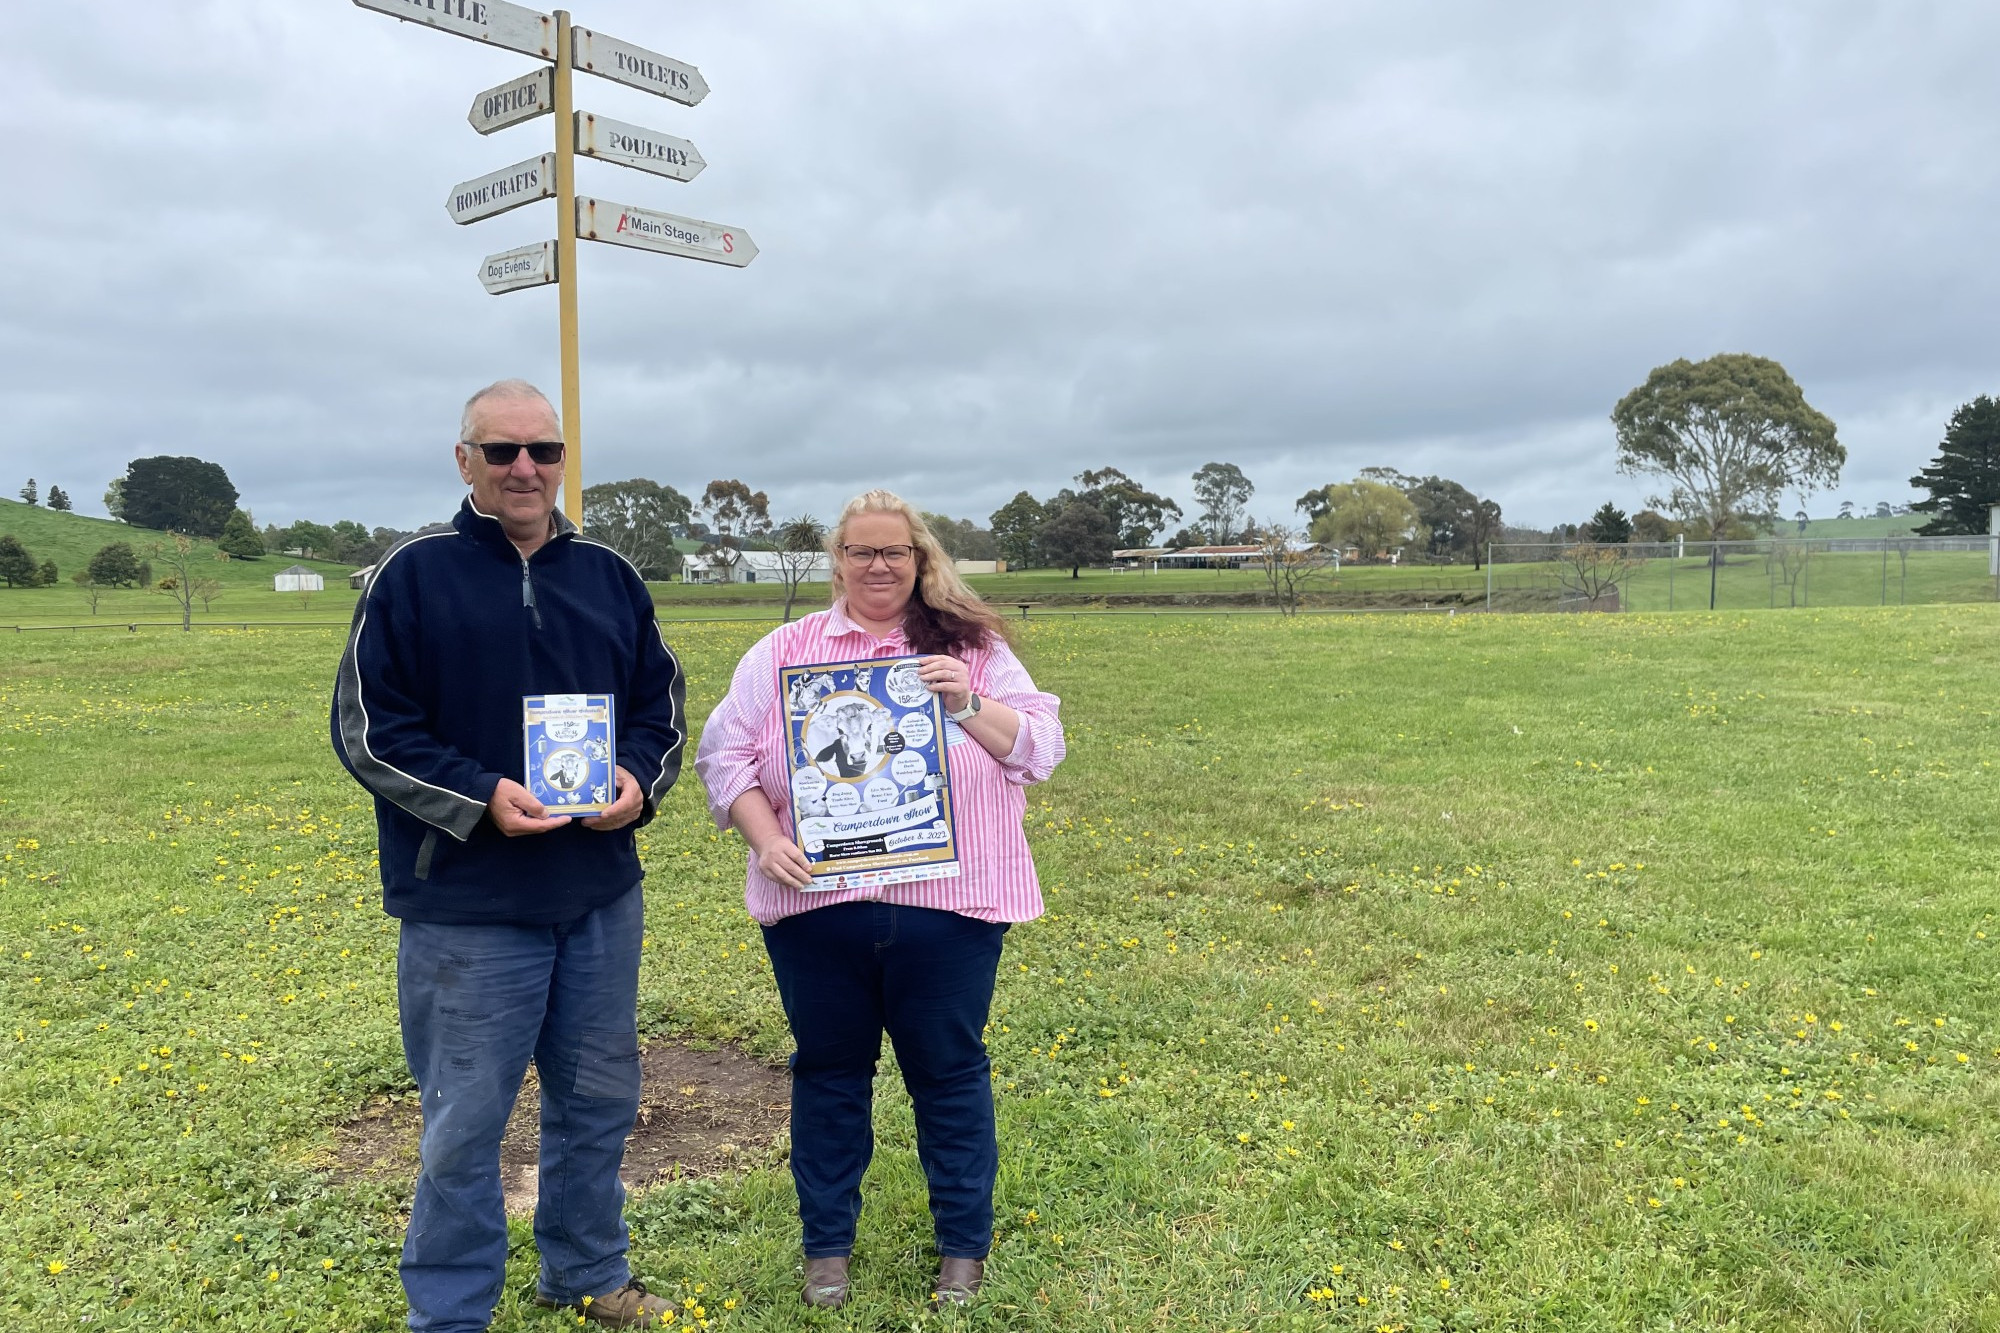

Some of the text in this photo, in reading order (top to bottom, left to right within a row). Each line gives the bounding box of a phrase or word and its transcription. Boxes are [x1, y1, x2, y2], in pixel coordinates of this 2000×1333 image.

[403, 0, 487, 26] TLE
[615, 51, 689, 90] TOILETS
[483, 83, 537, 118] OFFICE
[609, 131, 689, 167] POULTRY
[456, 170, 538, 212] HOME CRAFTS
[631, 217, 700, 244] Main Stage
[722, 233, 734, 253] S
[487, 259, 531, 278] Dog Events
[832, 804, 933, 833] Camperdown Show
[888, 834, 915, 847] October
[917, 832, 924, 840] 8,
